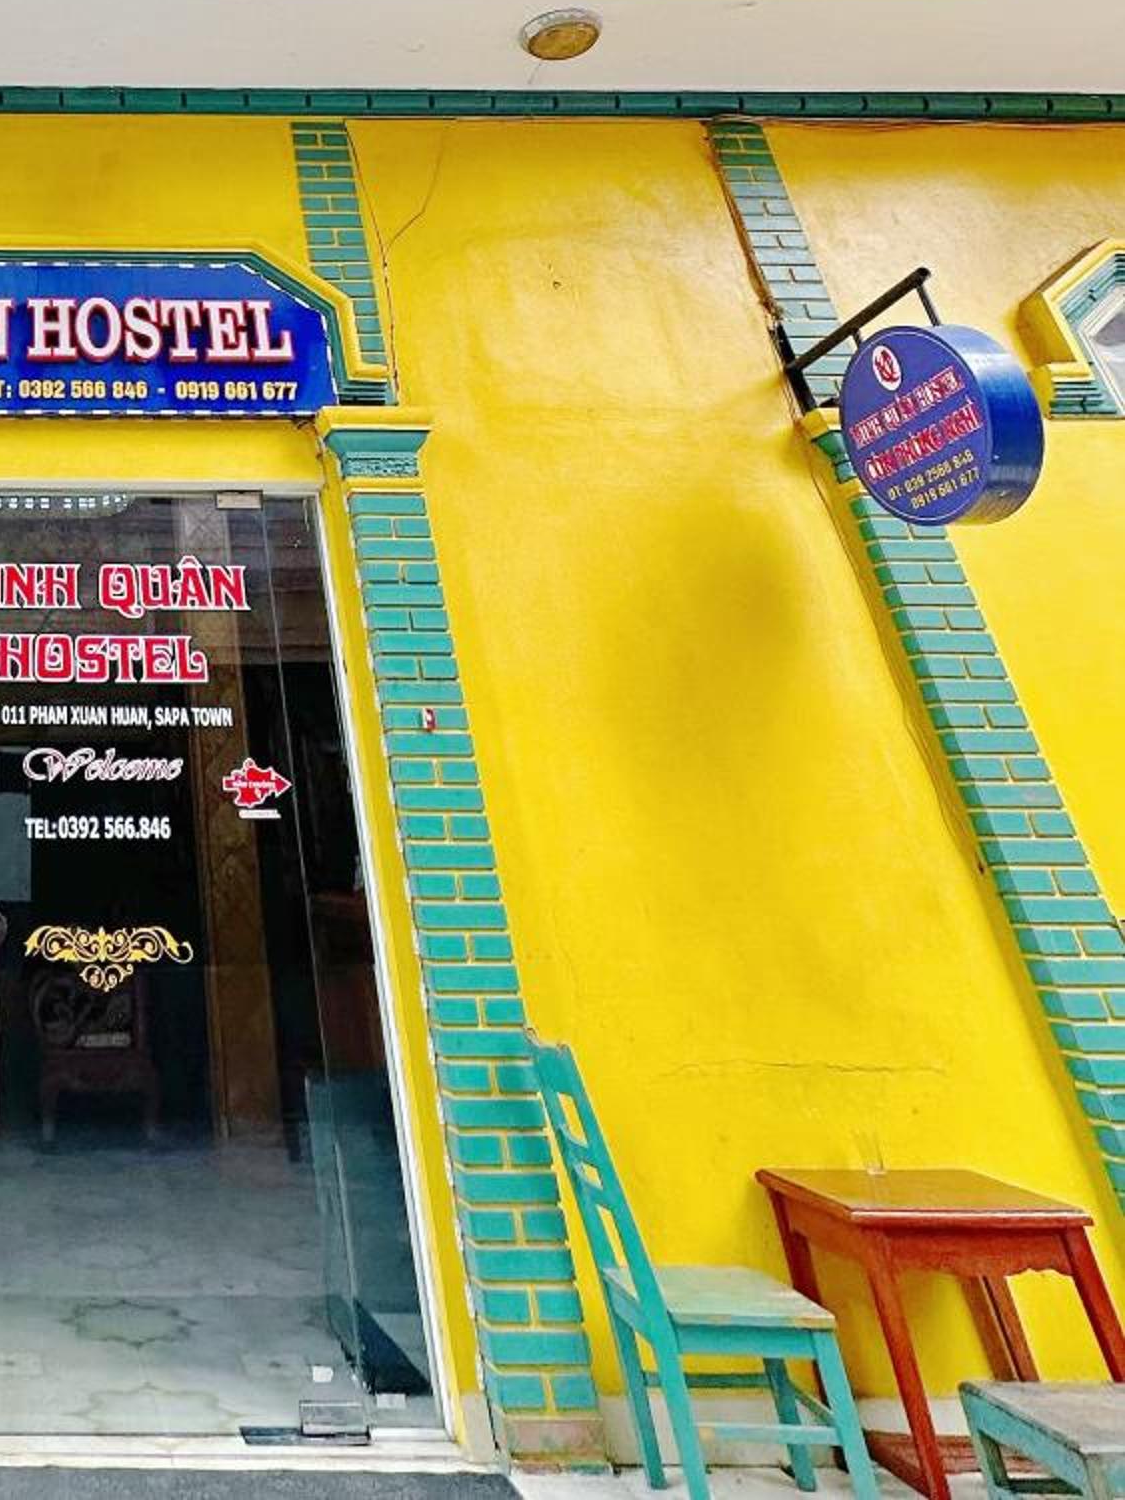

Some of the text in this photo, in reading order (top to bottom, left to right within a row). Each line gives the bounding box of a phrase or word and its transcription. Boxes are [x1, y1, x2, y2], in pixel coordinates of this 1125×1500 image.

[28, 297, 294, 363] HOSTEL
[18, 379, 65, 398] 0392
[71, 380, 106, 399] 566
[112, 380, 148, 399] 846
[175, 381, 219, 400] 0919
[224, 381, 258, 400] 661
[263, 381, 298, 400] 677
[99, 554, 252, 619] QUÂN
[1, 706, 25, 725] 011
[29, 707, 68, 725] PHAM
[70, 707, 107, 725] XUAN
[111, 707, 152, 730] HUAN,
[154, 707, 190, 726] SAPA
[191, 707, 233, 726] TOWN
[23, 747, 184, 783] Welcome
[104, 816, 171, 839] 566.846
